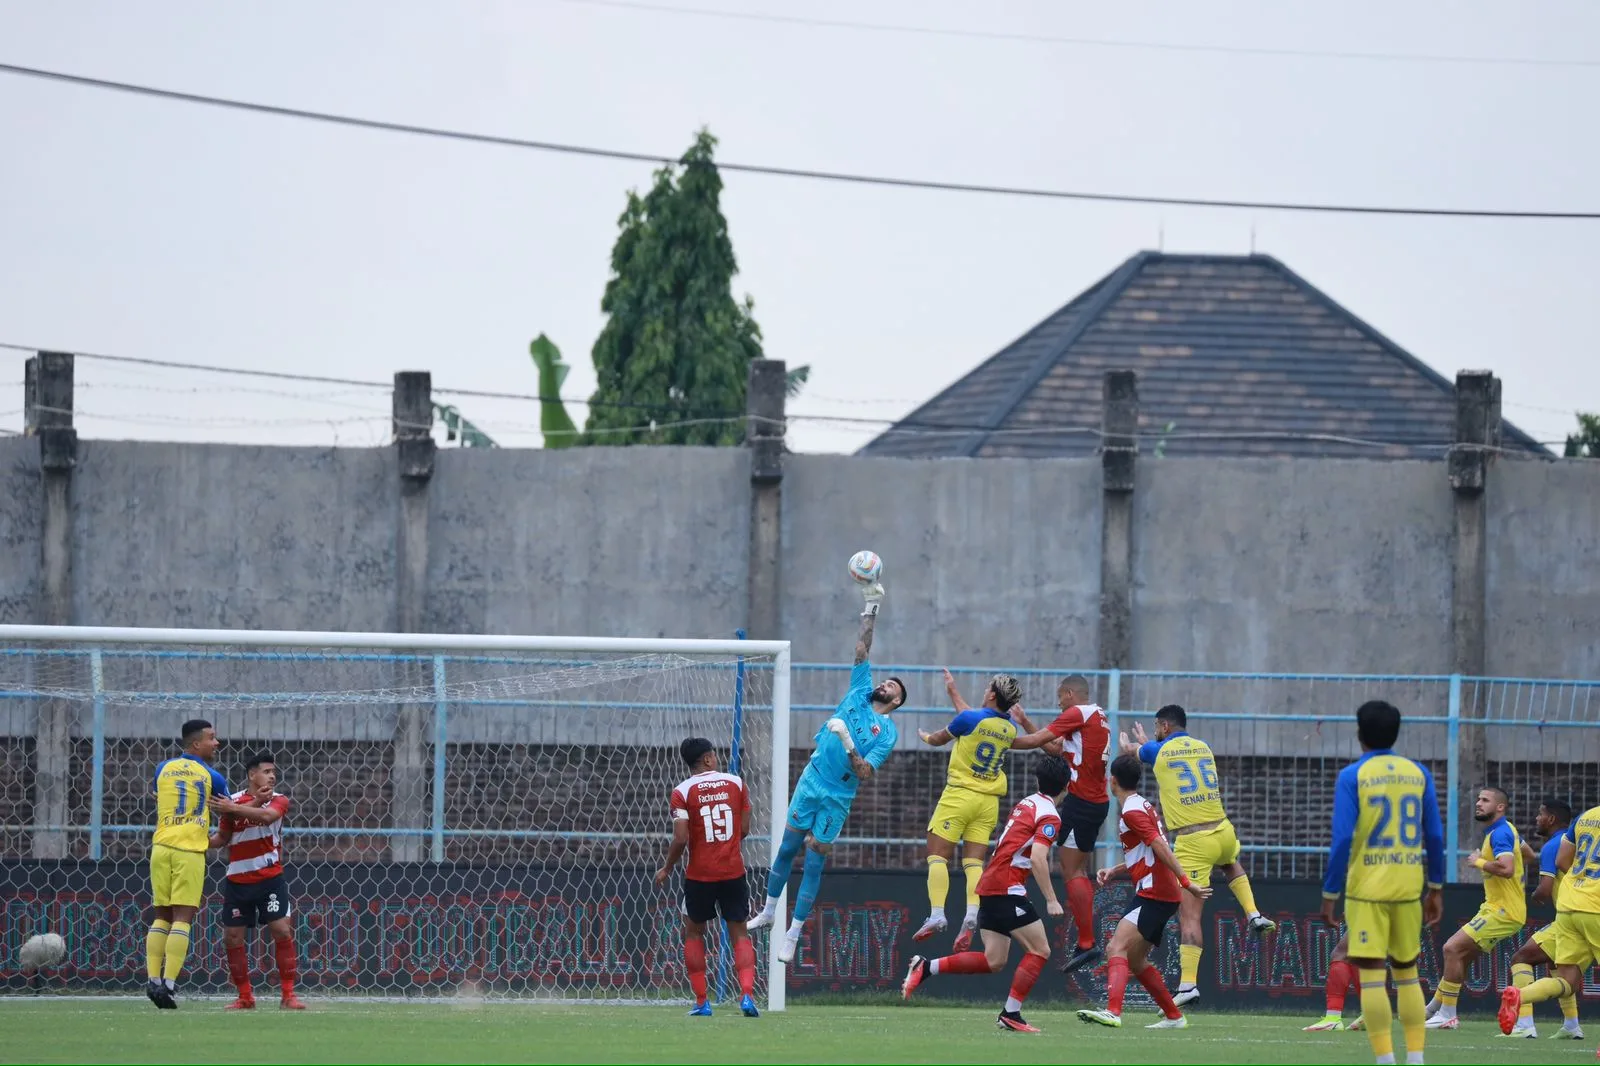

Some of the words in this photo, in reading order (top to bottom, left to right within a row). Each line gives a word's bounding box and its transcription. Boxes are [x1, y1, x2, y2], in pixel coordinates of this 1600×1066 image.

[1168, 758, 1219, 795] 36
[174, 780, 207, 818] 11
[1180, 794, 1206, 806] RENAN
[700, 803, 734, 843] 19
[1367, 793, 1423, 849] 28
[1363, 852, 1403, 866] BUYUNG
[267, 901, 280, 913] 26
